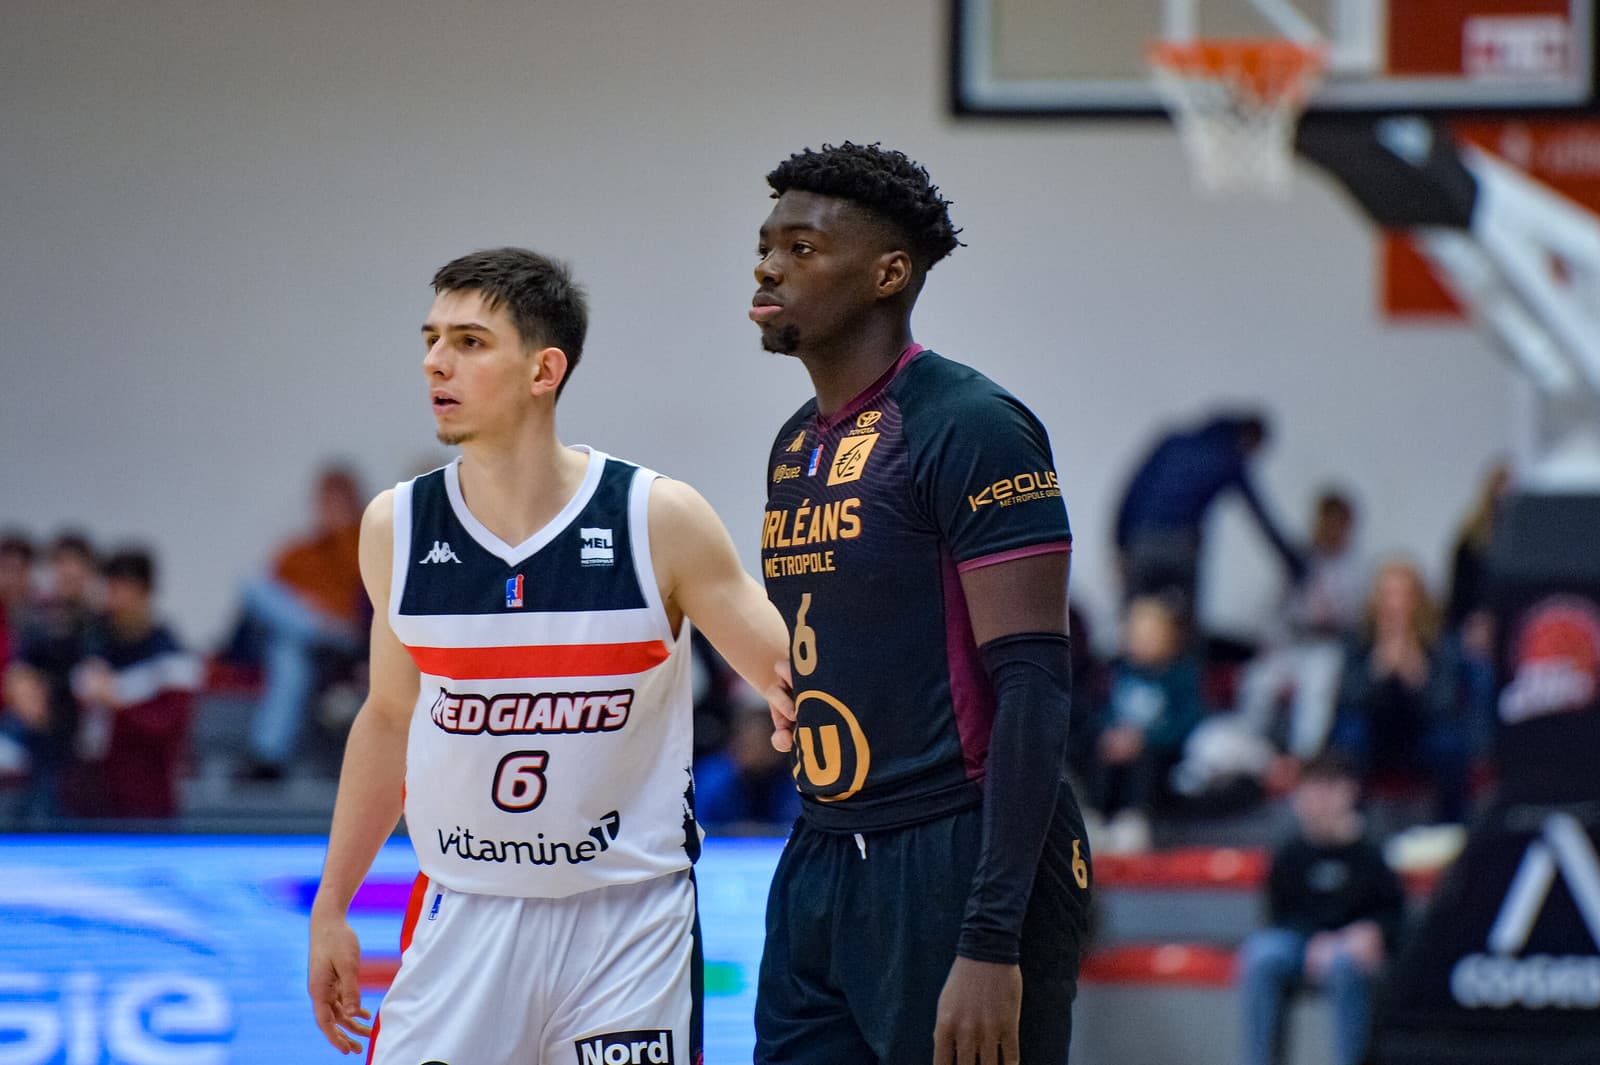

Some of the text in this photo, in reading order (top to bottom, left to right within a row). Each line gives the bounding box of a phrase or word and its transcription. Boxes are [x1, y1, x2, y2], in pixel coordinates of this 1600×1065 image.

[580, 537, 614, 549] MEL
[764, 550, 836, 579] MÉTROPOLE
[792, 592, 818, 677] 6
[492, 750, 550, 814] 6
[1071, 838, 1089, 889] 6
[580, 1032, 670, 1065] Nord
